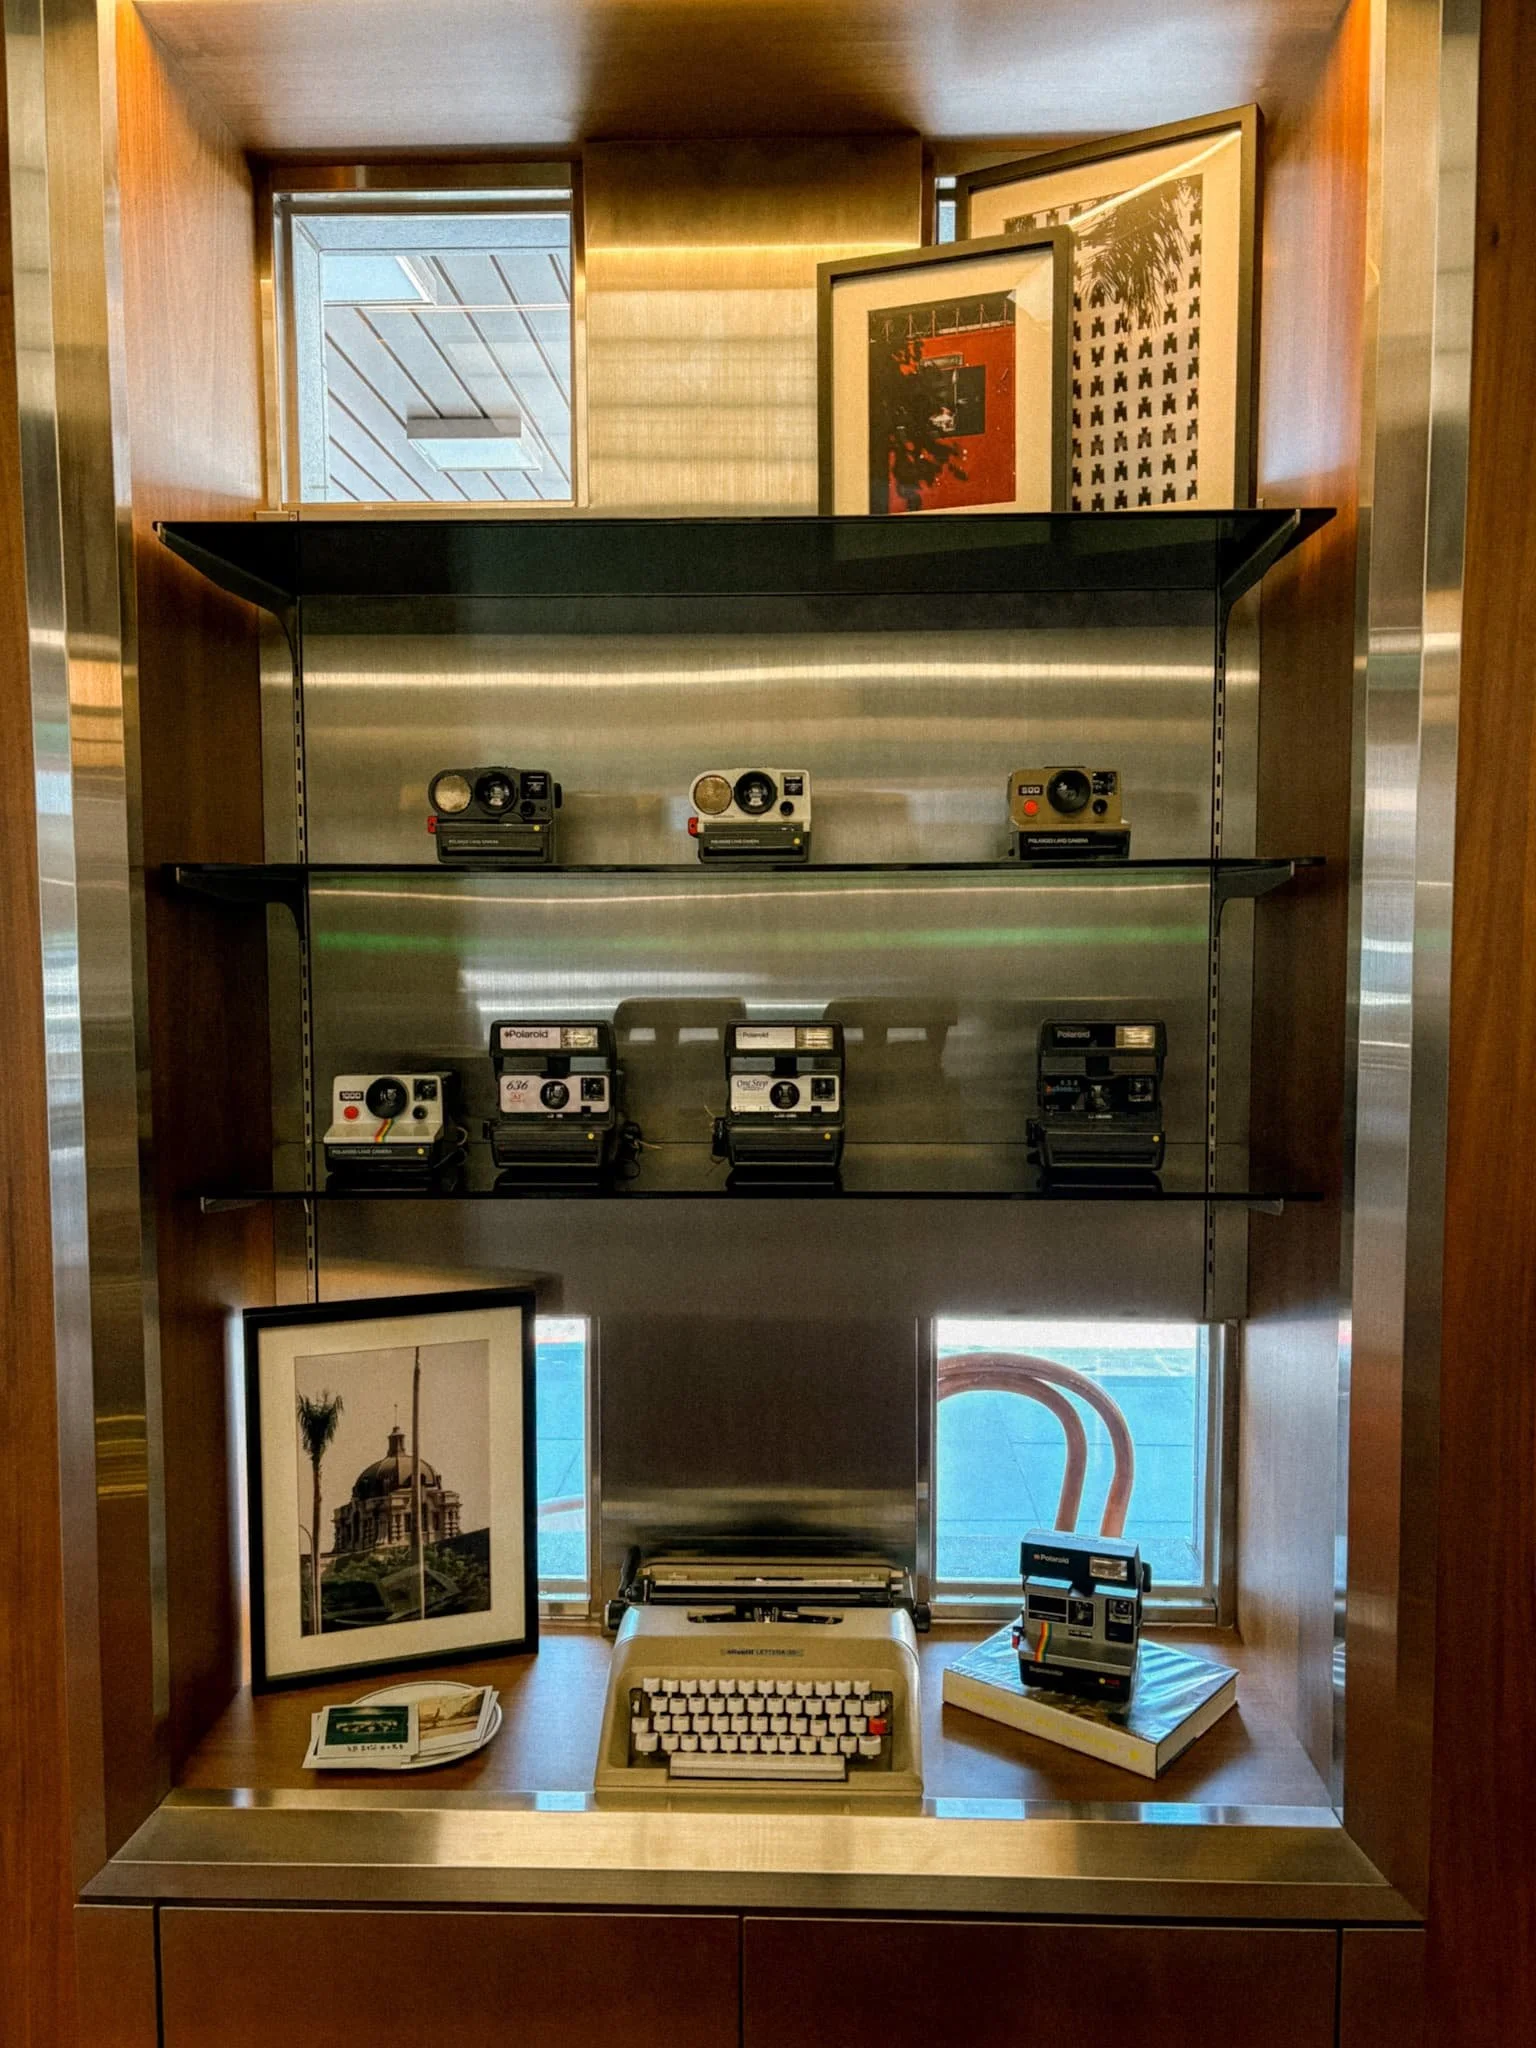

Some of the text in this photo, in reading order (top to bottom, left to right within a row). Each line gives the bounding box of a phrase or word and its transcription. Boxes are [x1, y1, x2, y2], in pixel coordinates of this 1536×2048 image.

[508, 1030, 549, 1038] Polaroid
[1057, 1030, 1090, 1039] Polaroid
[505, 1079, 529, 1091] 636
[1040, 1553, 1070, 1565] Polaroid
